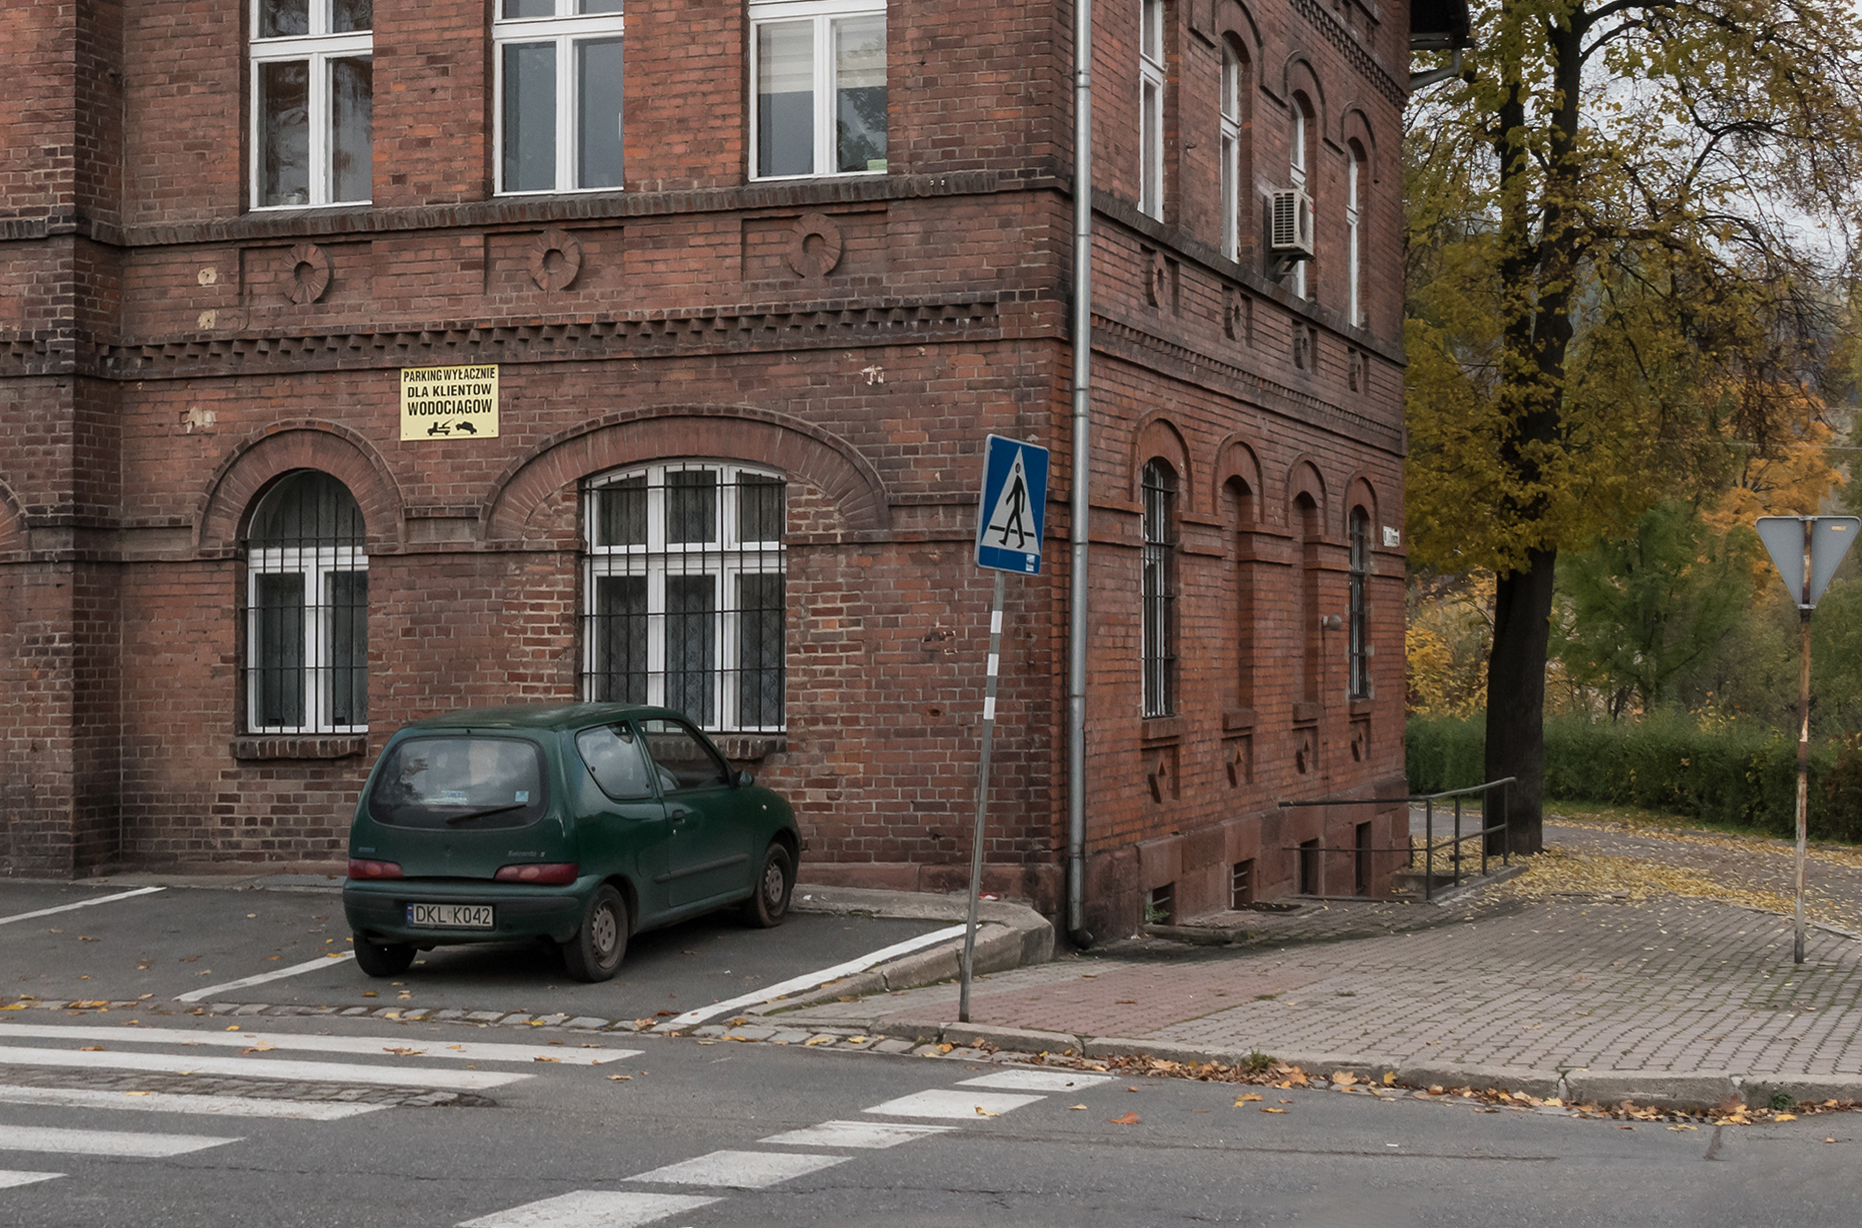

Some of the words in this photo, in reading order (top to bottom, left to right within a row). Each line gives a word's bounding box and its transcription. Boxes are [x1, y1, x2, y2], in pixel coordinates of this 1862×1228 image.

[404, 369, 441, 382] PARKING
[408, 386, 429, 398] DLA
[415, 905, 447, 923] DKL
[453, 906, 491, 925] K042
